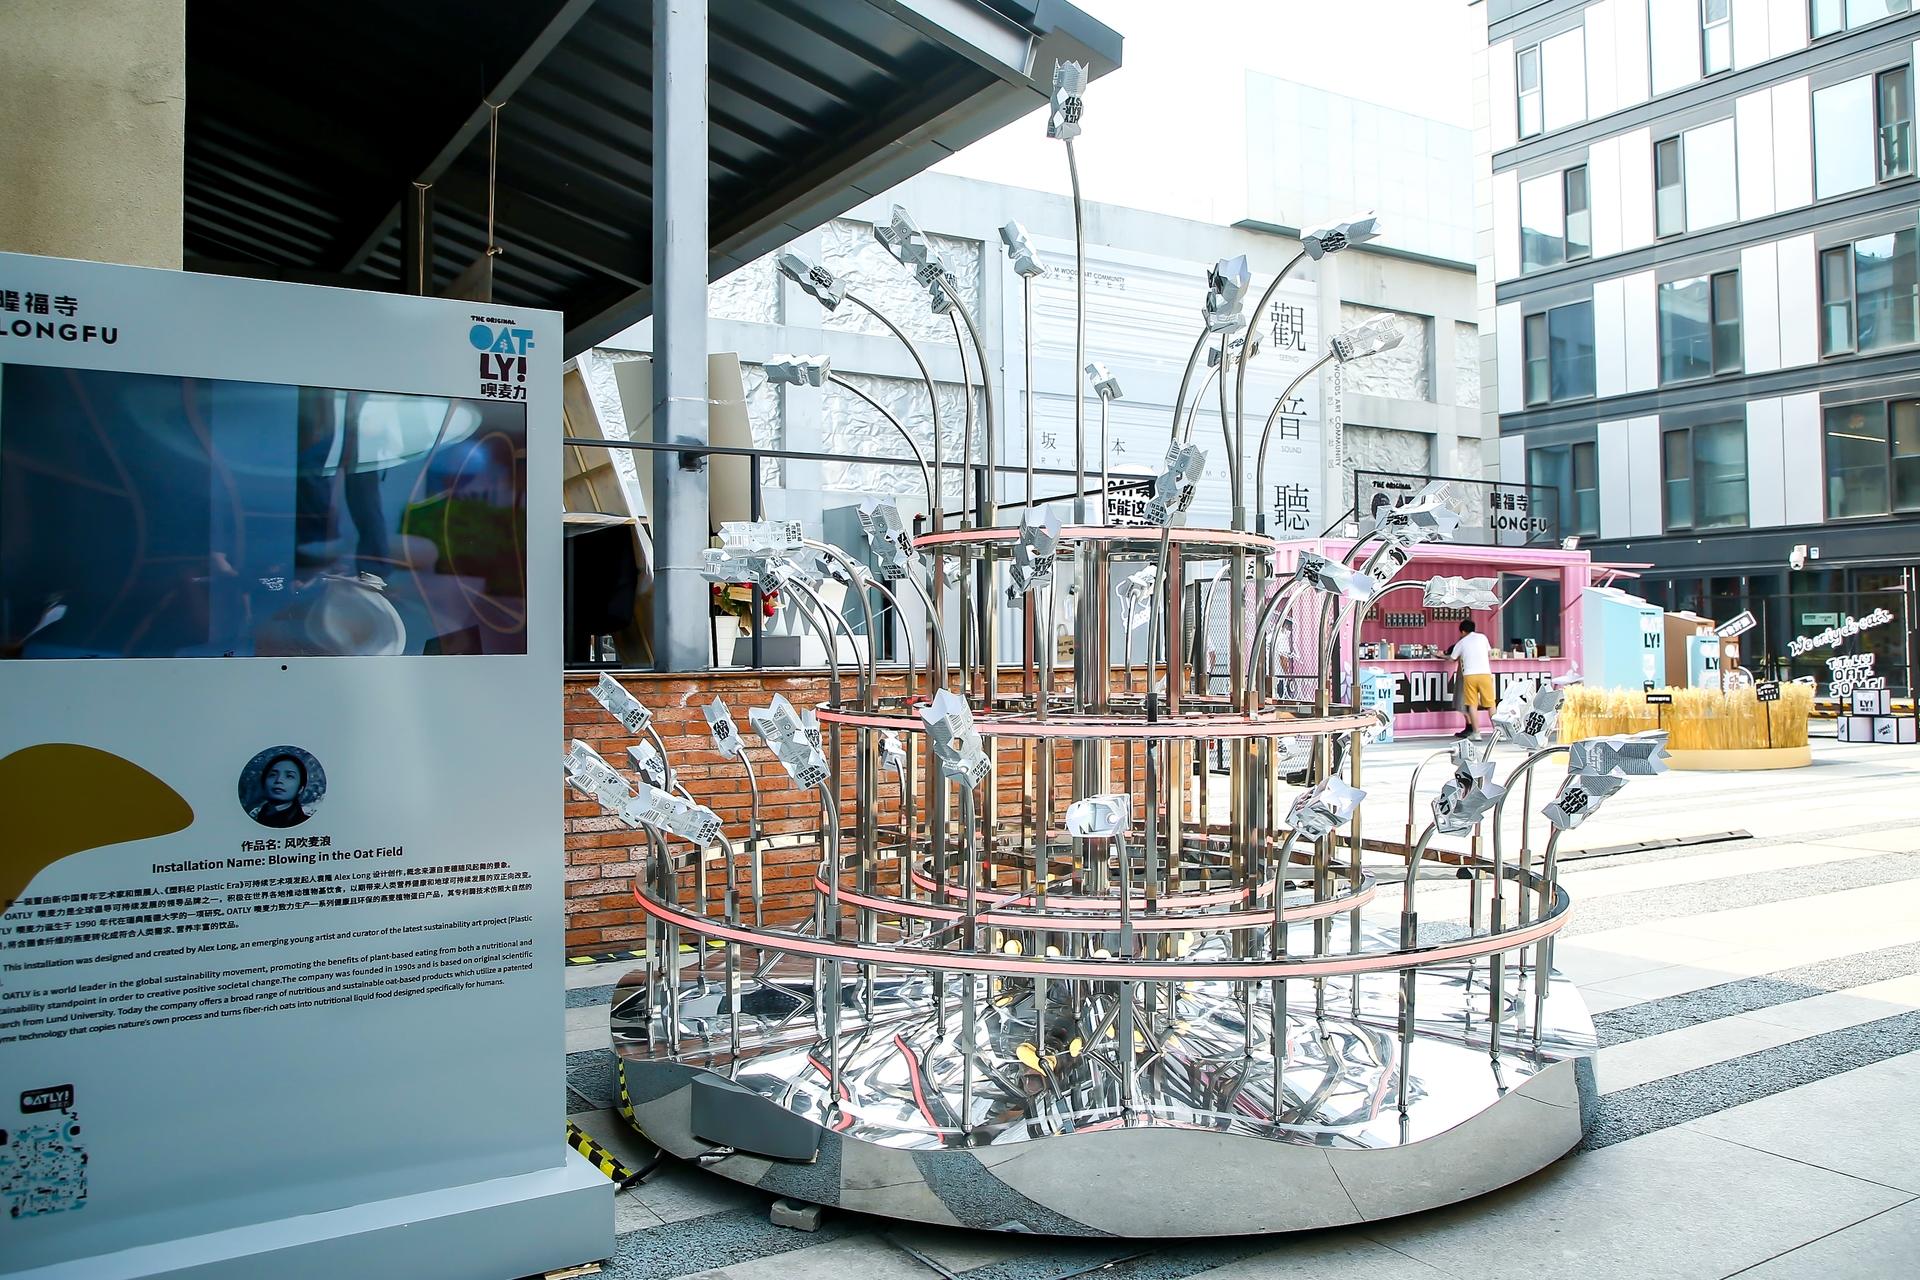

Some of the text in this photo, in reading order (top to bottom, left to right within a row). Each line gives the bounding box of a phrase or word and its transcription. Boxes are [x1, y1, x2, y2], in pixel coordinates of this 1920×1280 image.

[1061, 268, 1078, 276] WOOD
[0, 290, 78, 316] 隆福寺
[1270, 302, 1306, 352] 觀
[480, 353, 526, 382] LY!
[480, 383, 526, 400] 噢麦力
[1274, 396, 1308, 440] 音
[1041, 432, 1126, 456] 坂 本
[1274, 483, 1310, 532] 聽
[1490, 516, 1546, 532] LONGFU
[1644, 633, 1660, 648] LY!
[1705, 657, 1720, 670] LY
[1378, 688, 1390, 698] LY!
[1410, 672, 1457, 702] ONL
[284, 836, 331, 850] 风吹麦浪
[152, 846, 402, 874] Installation Name: Blowing in the Oat Field
[197, 883, 225, 892] Plastic
[4, 912, 33, 920] OATLY
[226, 907, 252, 915] OATLY
[4, 962, 21, 970] This
[24, 958, 73, 969] installation
[94, 951, 133, 962] designed
[135, 950, 151, 958] and
[152, 947, 184, 957] created
[185, 946, 196, 955] by
[216, 943, 238, 951] Long,
[251, 938, 288, 947] emerging
[289, 936, 314, 946] young
[315, 932, 335, 941] artist
[336, 931, 351, 939] and
[352, 929, 379, 938] curator
[380, 927, 388, 935] of
[402, 924, 422, 933] latest
[423, 920, 471, 931] sustainability
[471, 919, 482, 927] art
[482, 916, 507, 928] project
[2, 990, 30, 999] OATLY
[50, 985, 76, 994] world
[78, 983, 106, 992] leader
[108, 981, 117, 989] in
[119, 979, 133, 987] the
[135, 976, 162, 988] global
[164, 970, 220, 983] sustainability
[222, 966, 268, 977] movement,
[270, 962, 311, 974] promoting
[312, 960, 326, 968] the
[327, 956, 359, 966] benefits
[360, 955, 368, 963] of
[369, 950, 413, 964] plant-based
[414, 948, 438, 957] eating
[438, 947, 456, 955] from
[457, 944, 474, 953] both
[519, 938, 532, 946] and
[48, 996, 96, 1009] standpoint
[109, 994, 133, 1002] order
[146, 988, 180, 998] creative
[182, 985, 215, 996] positive
[217, 980, 249, 991] societal
[298, 973, 334, 982] company
[352, 966, 383, 976] founded
[385, 965, 392, 973] in
[394, 963, 415, 972] 1990s
[416, 961, 431, 969] and
[432, 960, 438, 968] is
[440, 958, 461, 967] based
[473, 953, 500, 964] original
[501, 950, 532, 960] scientific
[22, 1018, 43, 1026] from
[46, 1014, 68, 1023] Lund
[70, 1009, 115, 1020] University.
[118, 1006, 142, 1015] Today
[144, 1004, 158, 1012] the
[160, 1001, 197, 1010] company
[198, 998, 222, 1006] offers
[230, 993, 253, 1003] broad
[255, 992, 277, 1000] range
[278, 989, 287, 997] of
[288, 986, 325, 996] nutritious
[326, 983, 341, 992] and
[342, 979, 384, 990] sustainable
[385, 974, 420, 985] oat-based
[421, 971, 453, 983] products
[454, 968, 474, 978] which
[502, 962, 532, 974] patented
[19, 1030, 66, 1041] technology
[69, 1026, 86, 1035] that
[88, 1024, 116, 1033] copies
[171, 1014, 202, 1025] process
[204, 1010, 219, 1019] and
[242, 1003, 278, 1015] fiber-rich
[279, 1002, 296, 1010] oats
[297, 1000, 312, 1008] into
[353, 992, 374, 1002] liquid
[375, 990, 392, 999] food
[392, 986, 425, 997] designed
[426, 982, 464, 994] specifically
[476, 979, 504, 987] humans.
[24, 1090, 69, 1106] OATLY!
